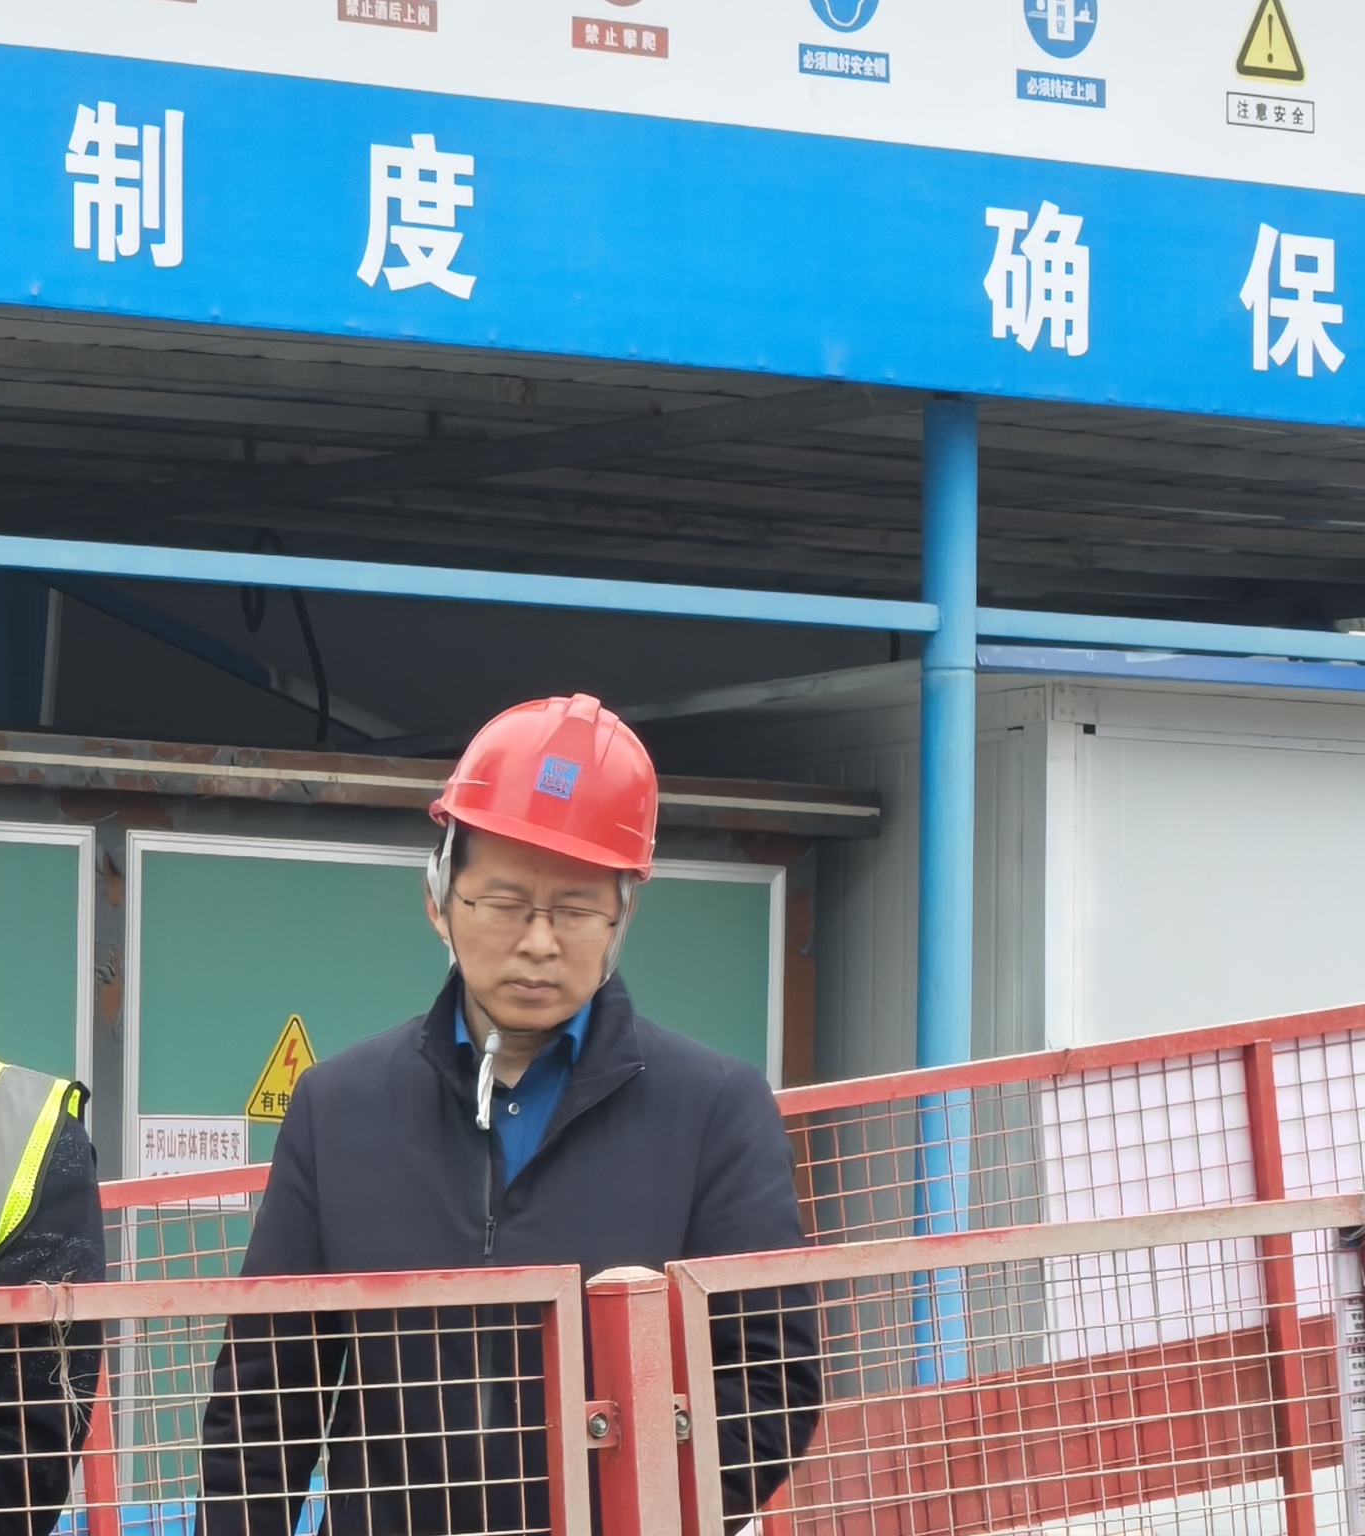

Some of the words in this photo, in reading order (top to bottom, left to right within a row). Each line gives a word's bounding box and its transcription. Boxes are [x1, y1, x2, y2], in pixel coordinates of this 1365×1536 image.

[1236, 99, 1305, 126] 注意安全
[984, 201, 1345, 377] 确保
[145, 1127, 241, 1161] 井冈山市体育馆专变
